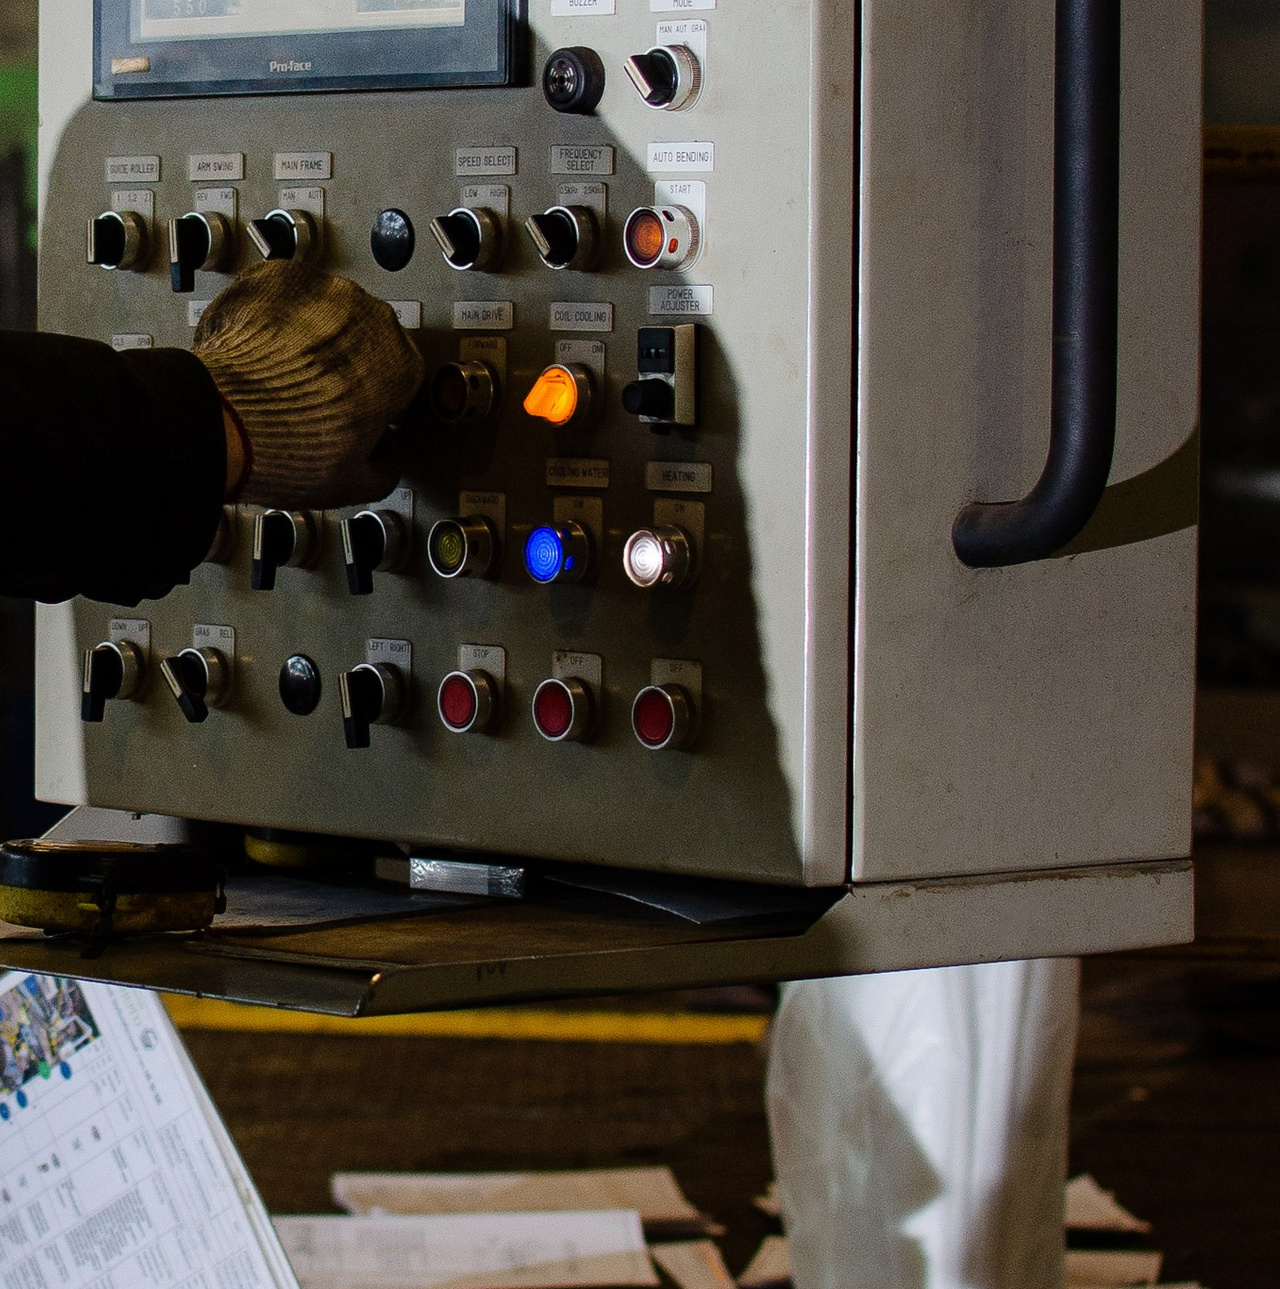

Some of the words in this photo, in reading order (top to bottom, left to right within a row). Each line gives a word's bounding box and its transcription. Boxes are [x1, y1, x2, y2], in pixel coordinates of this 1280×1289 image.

[659, 25, 672, 34] MAN
[559, 149, 603, 160] FREQUENCY
[653, 152, 673, 163] AUTO
[676, 151, 709, 162] BENDING
[281, 161, 298, 171] MAIN
[300, 160, 323, 171] FRAME
[457, 155, 481, 167] SPEED
[484, 154, 511, 166] SELECT
[567, 160, 595, 171] SELECT
[130, 163, 155, 174] ROLLER
[197, 162, 211, 172] ARM
[213, 161, 234, 171] SWING
[464, 188, 478, 198] LOW
[669, 184, 691, 194] START
[667, 289, 693, 300] POWER
[660, 301, 700, 312] ADJUSTER
[554, 311, 571, 321] COIL
[575, 311, 606, 322] COOLING
[560, 343, 572, 352] OFF
[662, 471, 696, 482] HEATING
[472, 648, 489, 659] STOP
